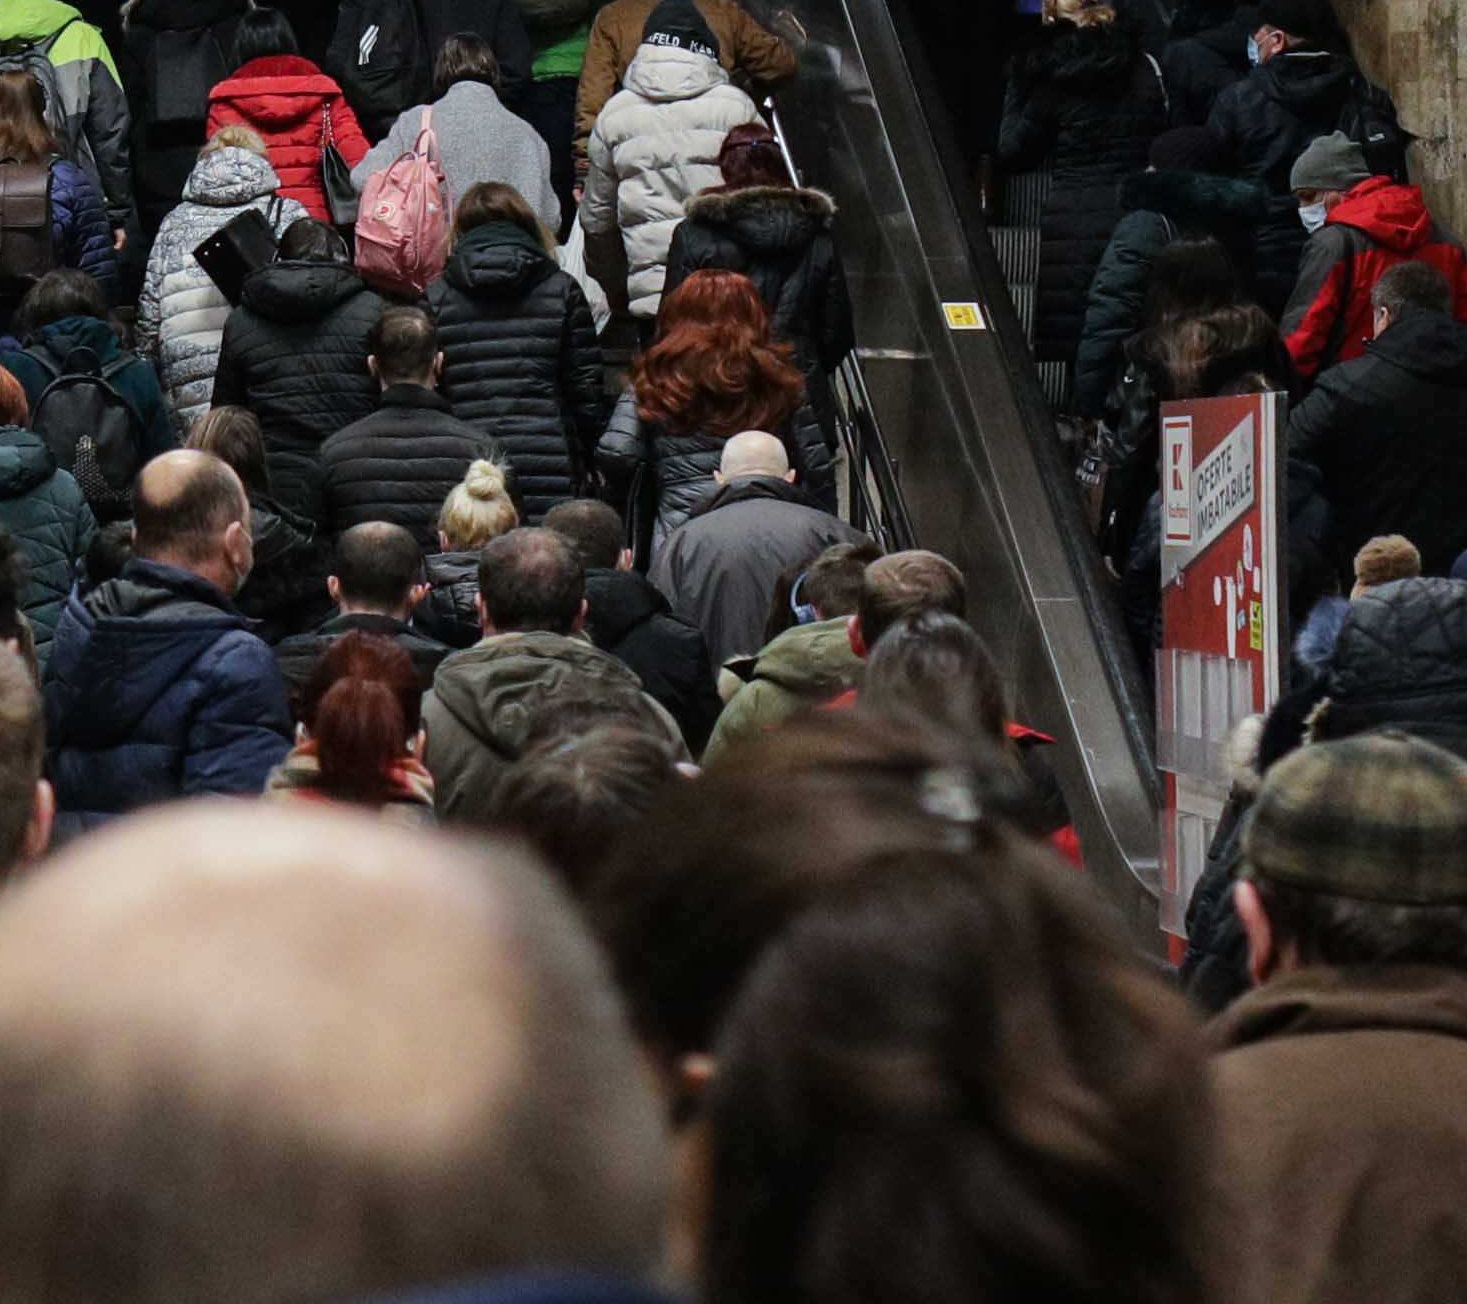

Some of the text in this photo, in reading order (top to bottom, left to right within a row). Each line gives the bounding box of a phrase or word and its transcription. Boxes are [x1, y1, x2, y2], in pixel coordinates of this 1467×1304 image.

[1173, 443, 1184, 491] K
[1197, 443, 1233, 502] OFERTE
[1197, 463, 1251, 540] IMBATABILE
